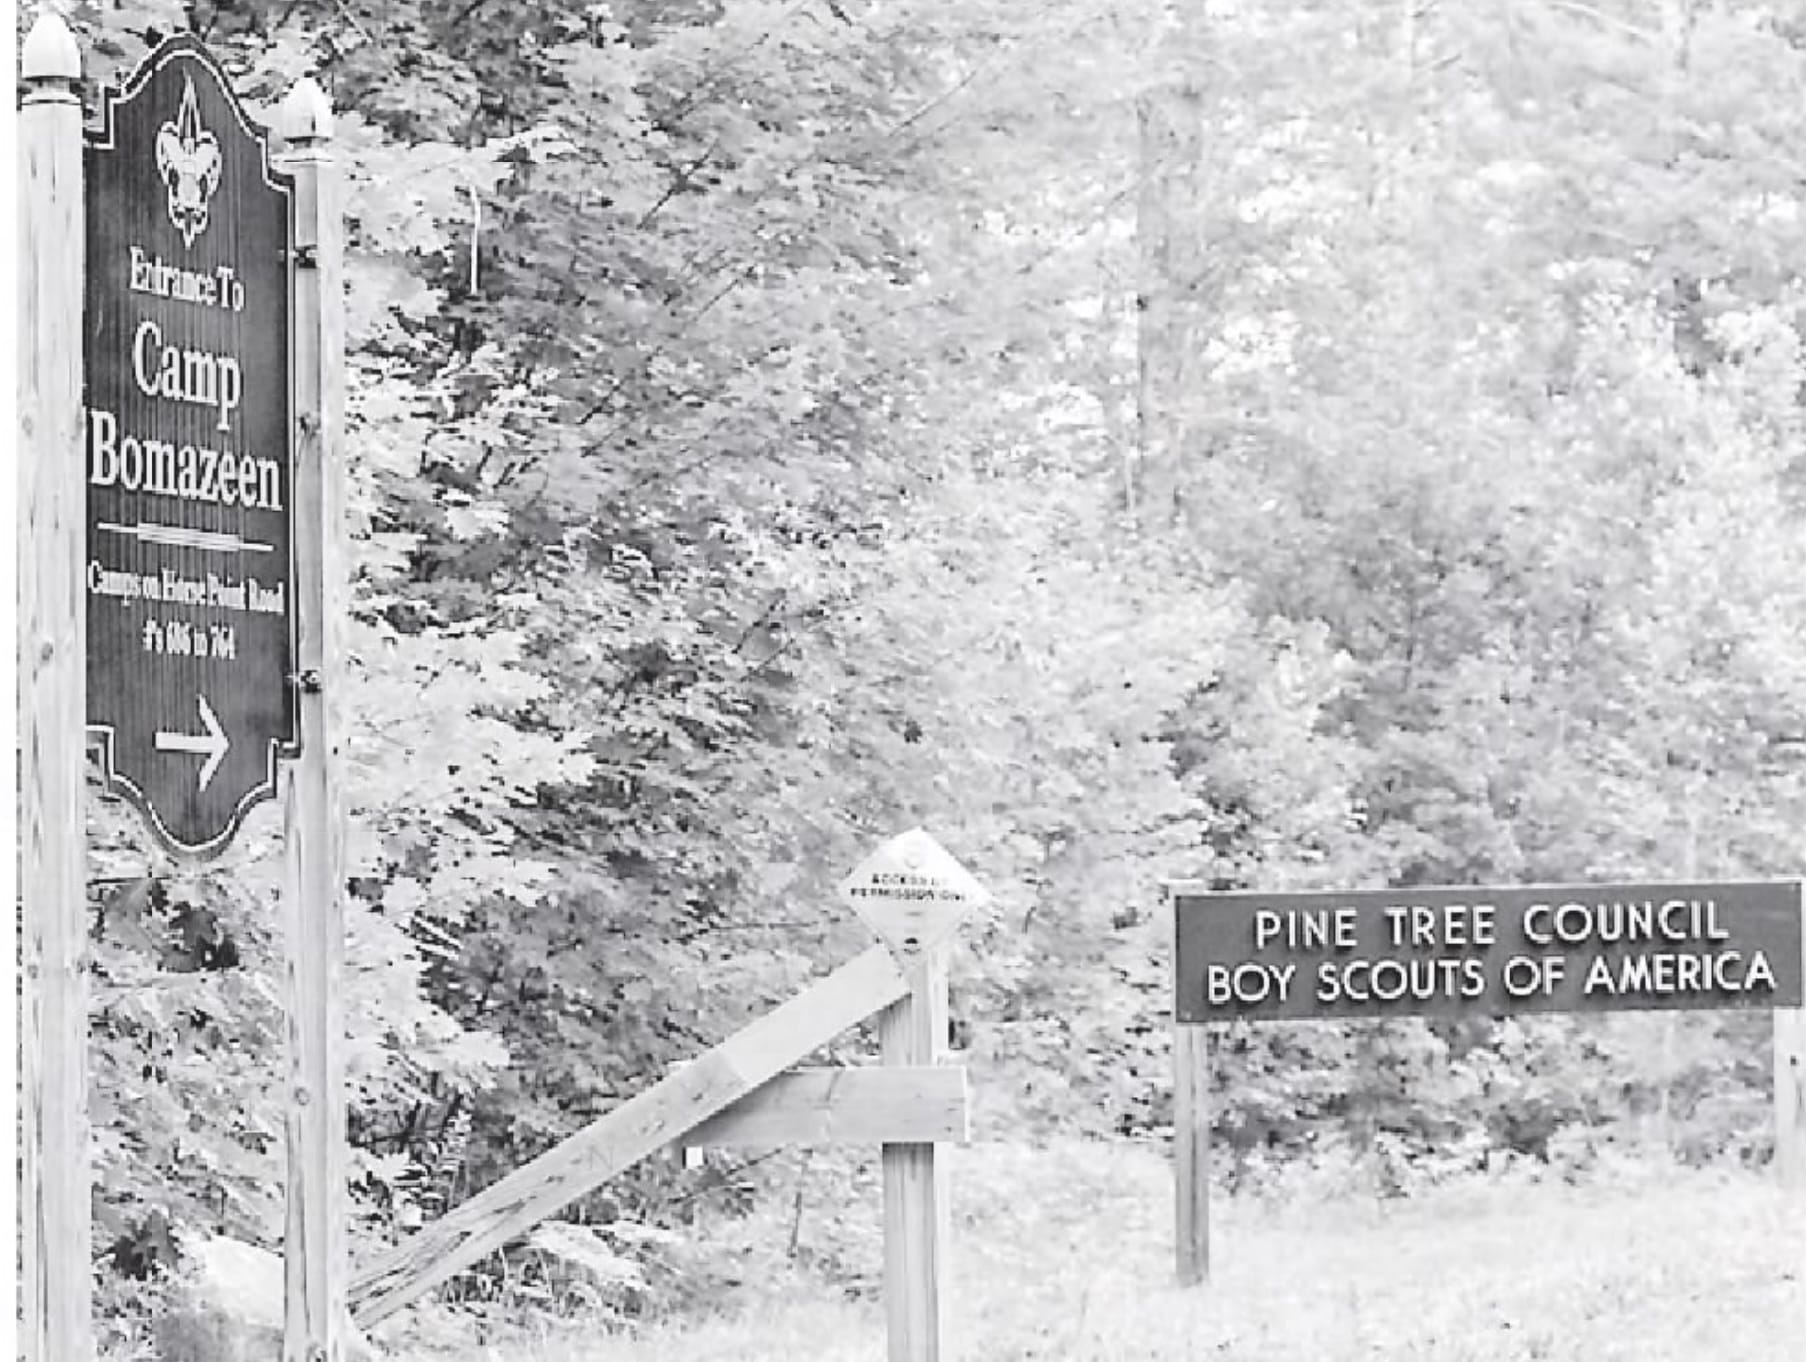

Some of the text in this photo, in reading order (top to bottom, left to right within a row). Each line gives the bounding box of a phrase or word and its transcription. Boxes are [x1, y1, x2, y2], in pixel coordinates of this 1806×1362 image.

[129, 245, 245, 312] Entrance To
[134, 320, 241, 431] Camp
[89, 410, 284, 512] Bomazeen
[1255, 900, 1731, 950] PINE TREE COUNCIL
[1207, 950, 1779, 1004] BOY SCOUTS OF AMERICA
